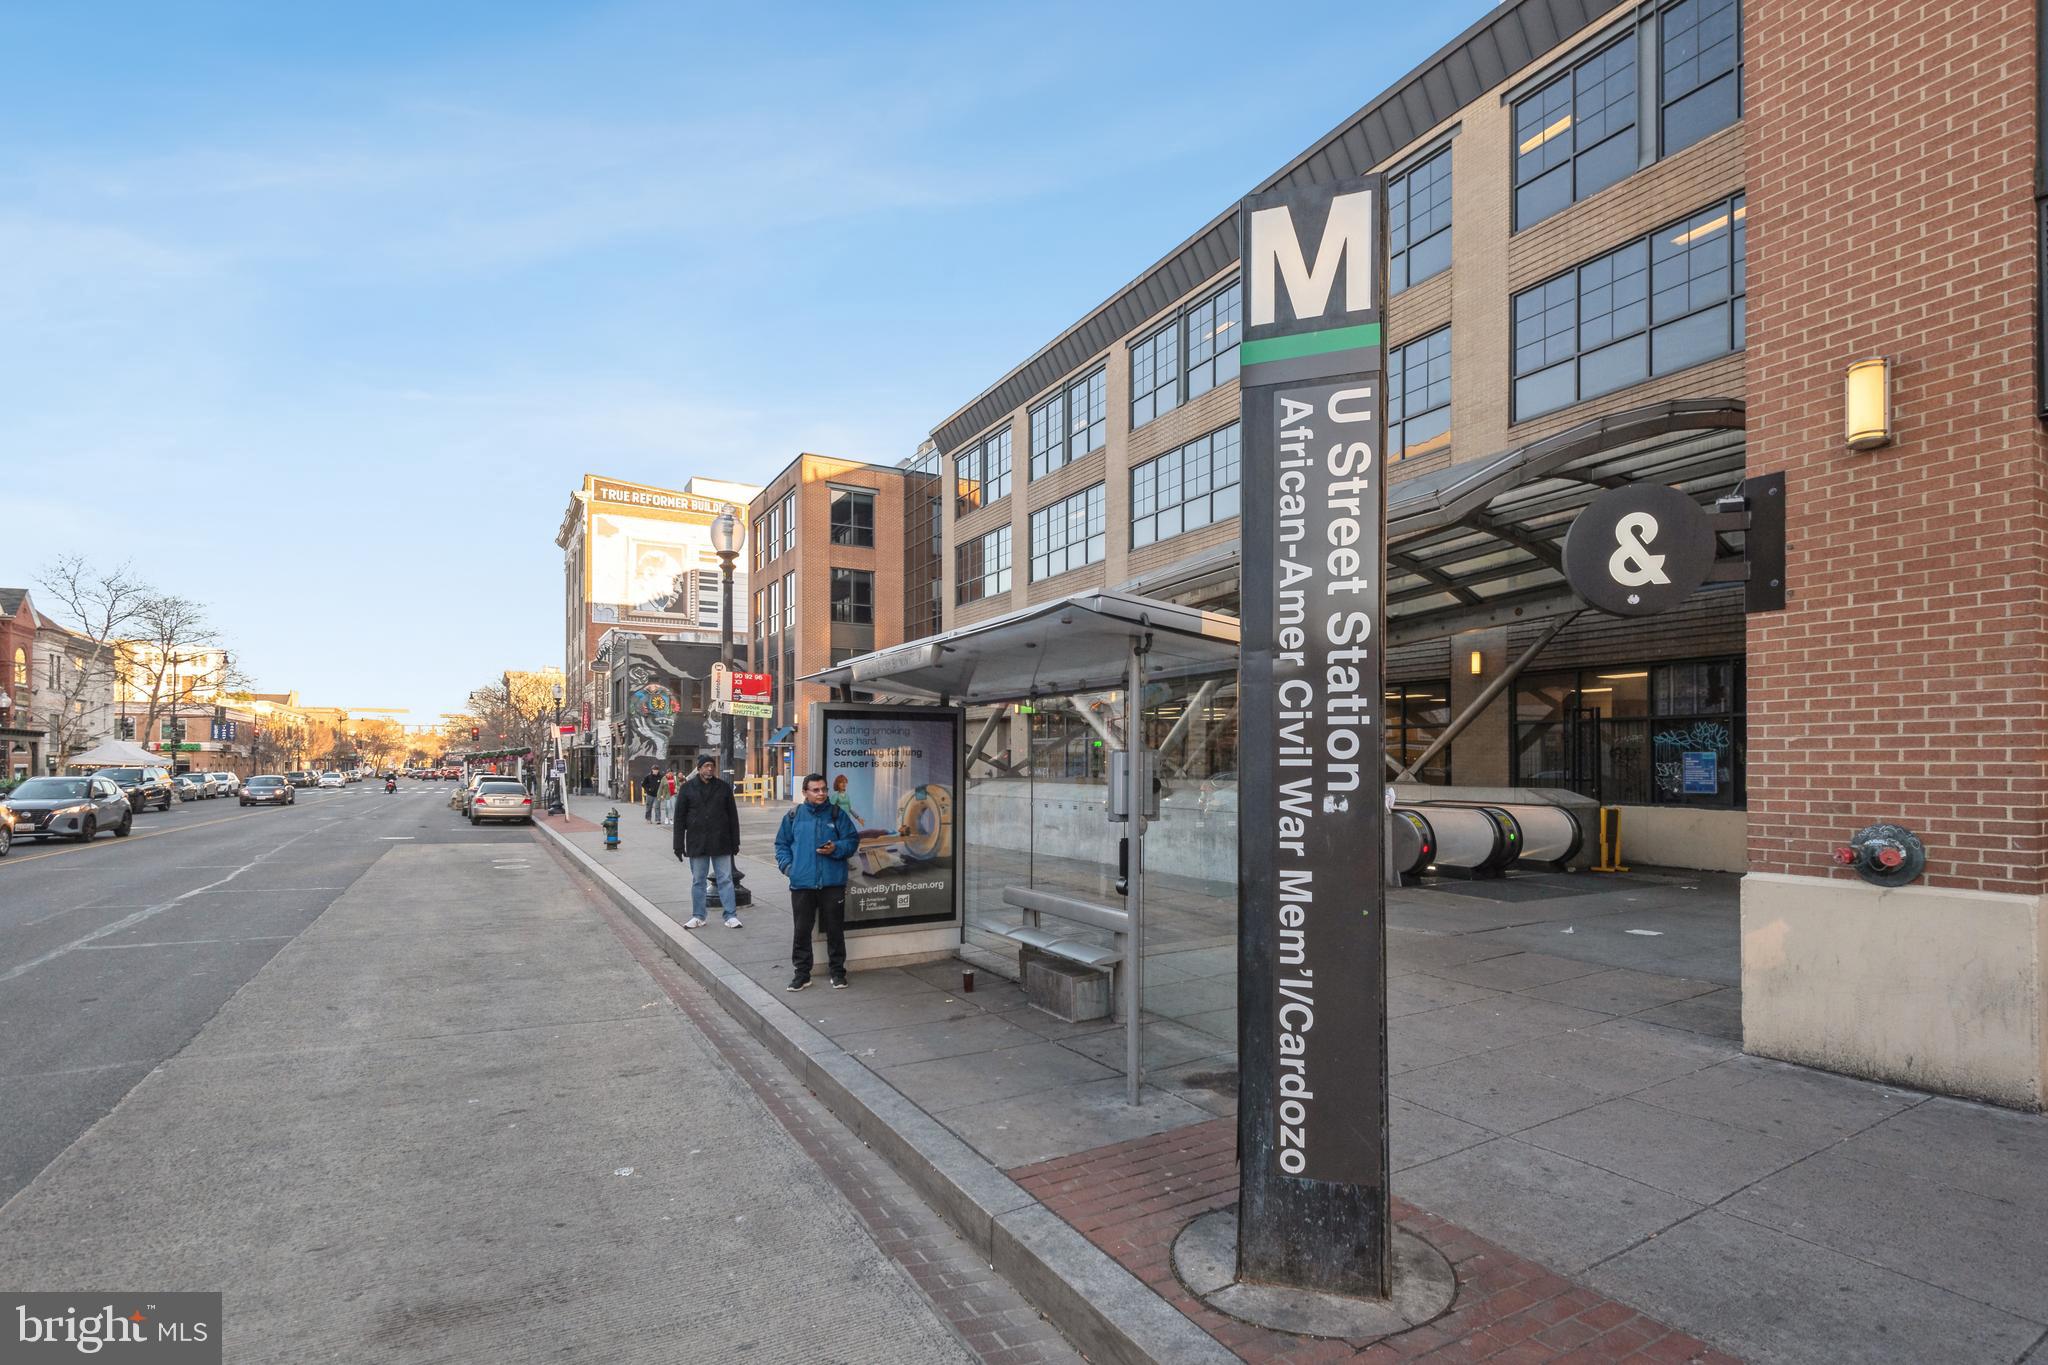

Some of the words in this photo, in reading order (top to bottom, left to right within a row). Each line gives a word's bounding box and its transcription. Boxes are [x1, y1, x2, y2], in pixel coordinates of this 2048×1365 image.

[1251, 190, 1371, 327] M
[1327, 387, 1372, 424] U
[600, 488, 630, 502] TRUE
[632, 493, 688, 510] REFORMER
[1327, 441, 1371, 596] Street
[1278, 397, 1314, 667] African-Amer
[1608, 511, 1671, 587] &
[1278, 679, 1313, 767] Civil
[1326, 611, 1371, 791] Station
[833, 724, 870, 737] Quitting
[871, 725, 911, 737] smoking
[833, 738, 854, 746] was
[833, 747, 885, 758] Screening
[887, 747, 900, 757] for
[901, 748, 923, 758] lung
[833, 760, 869, 768] cancer
[871, 759, 880, 768] is
[882, 761, 907, 769] easy.
[1278, 775, 1313, 857] War
[850, 881, 945, 895] SavedByTheScan.org
